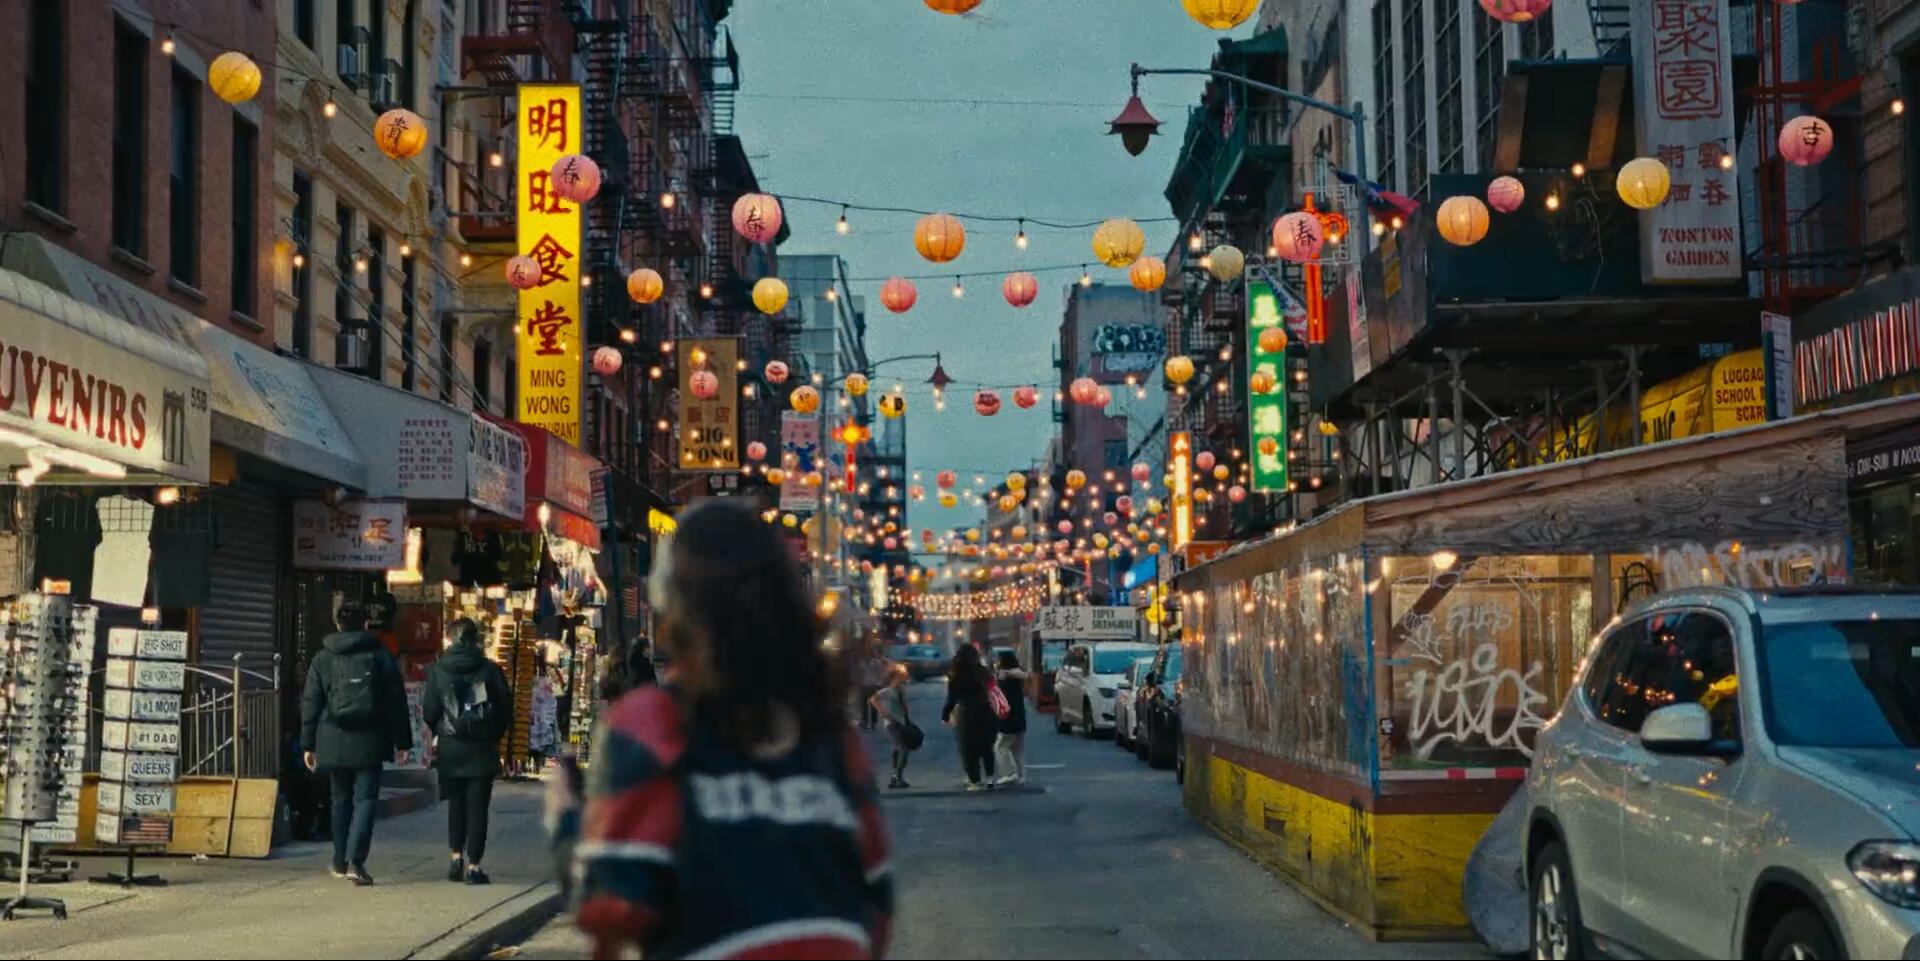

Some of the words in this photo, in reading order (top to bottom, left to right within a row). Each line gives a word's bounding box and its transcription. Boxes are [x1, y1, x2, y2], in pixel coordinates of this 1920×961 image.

[527, 97, 575, 356] 明旺食堂
[1296, 219, 1317, 247] 春
[1659, 226, 1734, 244] WONTON
[1665, 249, 1730, 266] GARDEN
[530, 369, 566, 388] MING
[1715, 387, 1756, 404] SCHOOL
[526, 395, 571, 415] WONG
[160, 638, 183, 652] SHOT
[155, 700, 178, 713] MOM
[153, 731, 177, 744] DAD
[131, 761, 171, 776] QUEENS
[134, 793, 161, 807] SEXY
